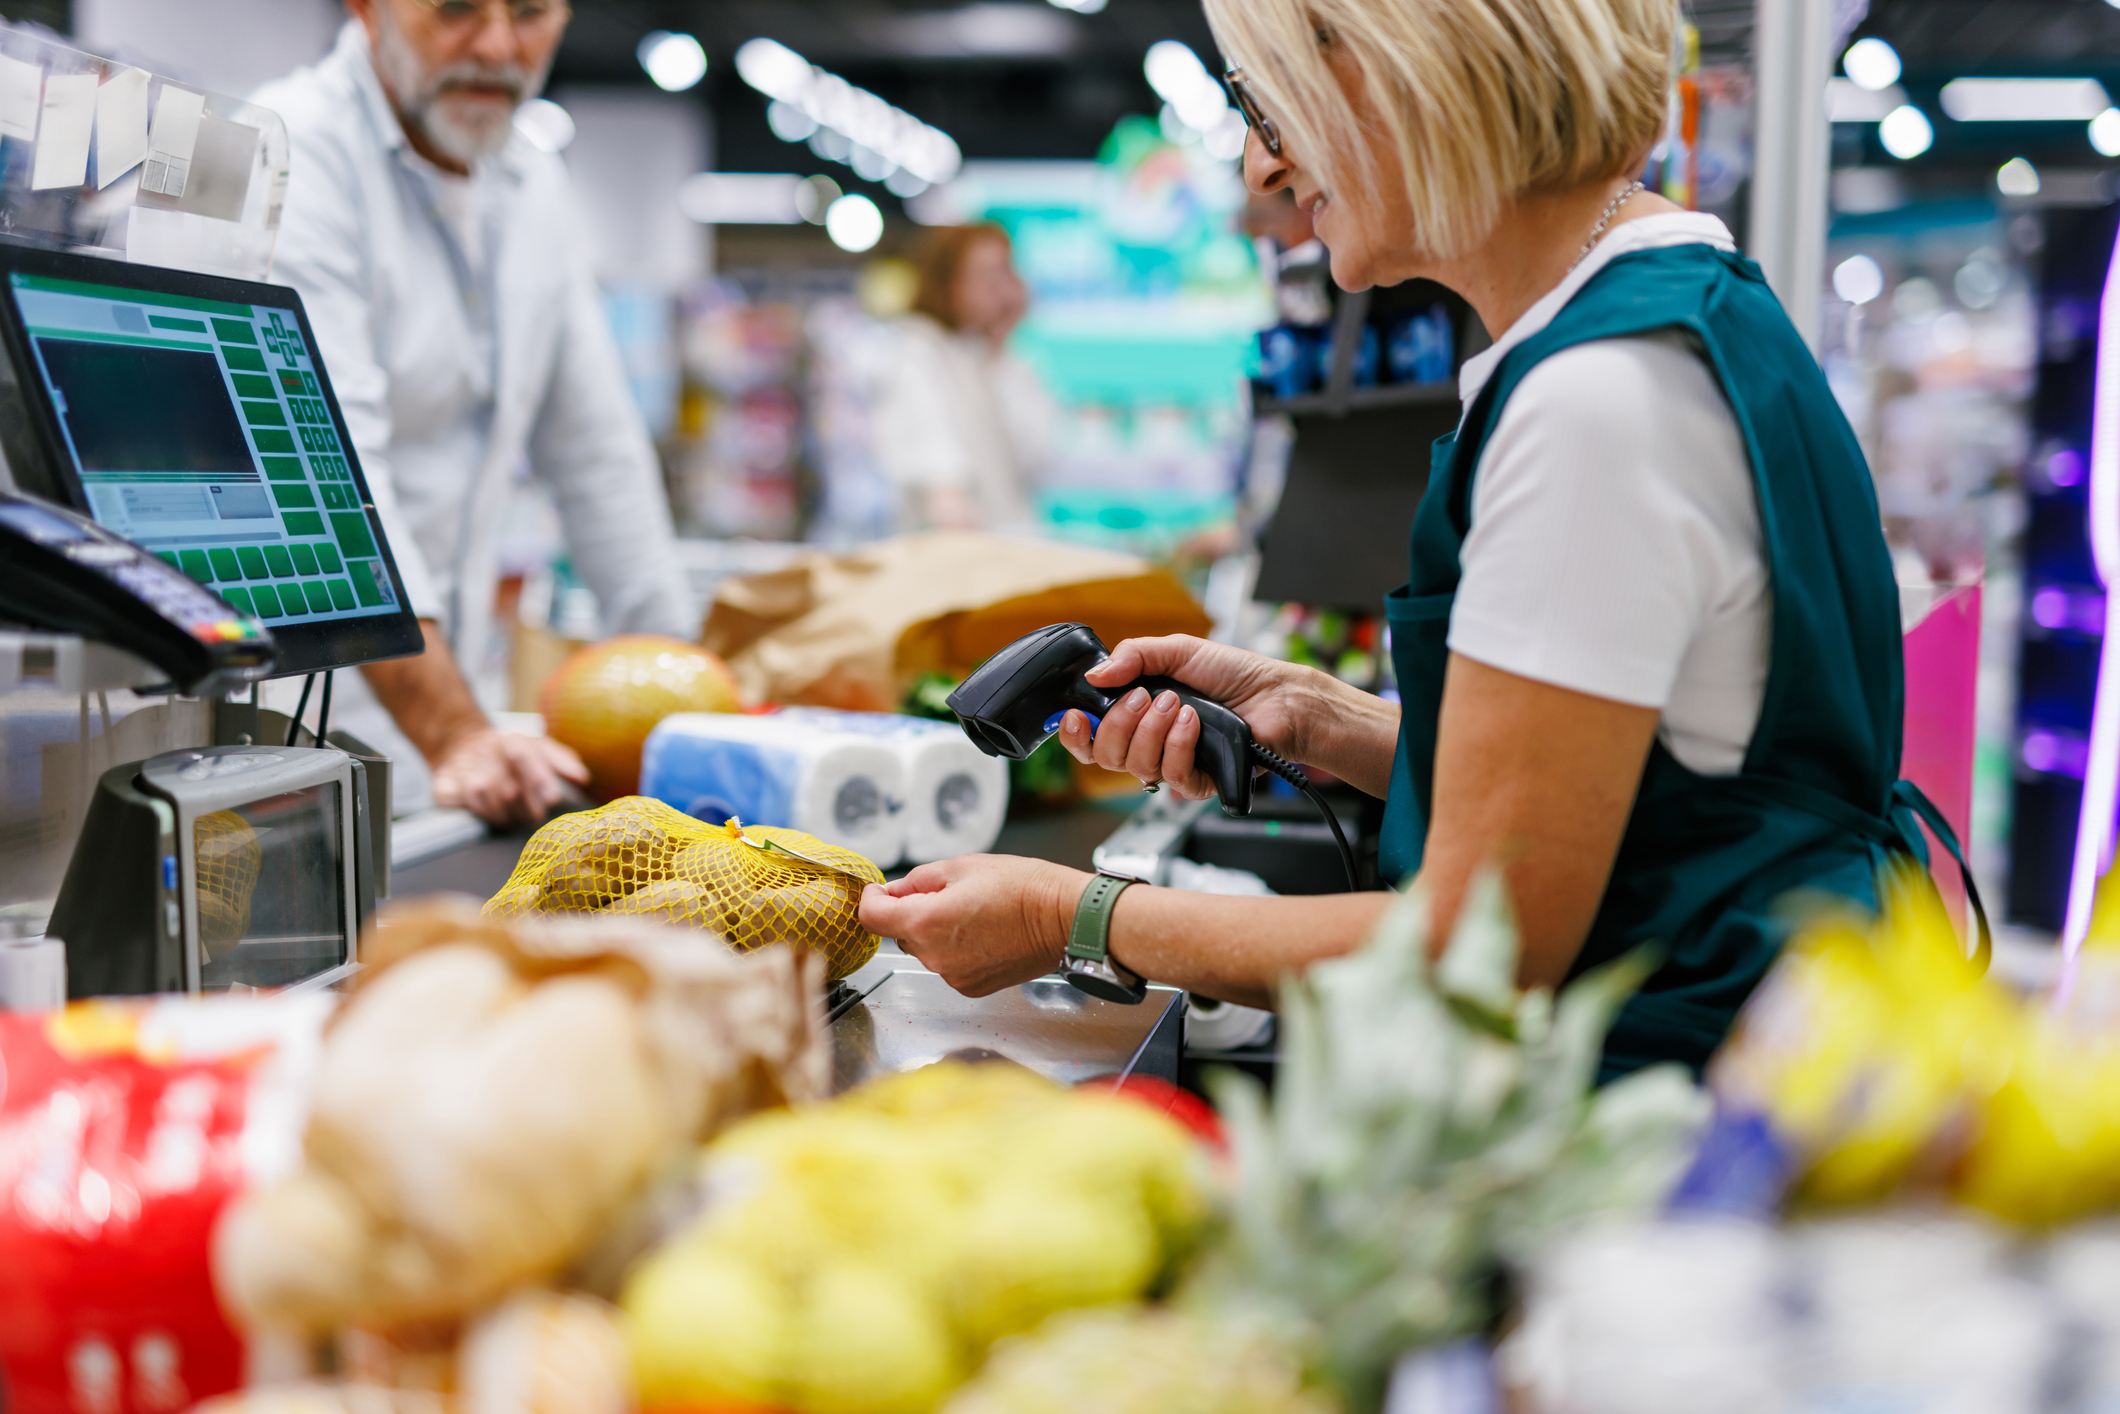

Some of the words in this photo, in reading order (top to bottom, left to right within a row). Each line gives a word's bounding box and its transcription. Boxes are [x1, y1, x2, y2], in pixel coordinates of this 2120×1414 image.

[291, 404, 298, 415] 7
[304, 433, 310, 444] 4
[315, 433, 322, 445] 5
[328, 433, 334, 445] 6
[313, 462, 319, 473] 1
[325, 462, 332, 474] 2
[337, 462, 344, 474] 3
[330, 491, 337, 503] 0
